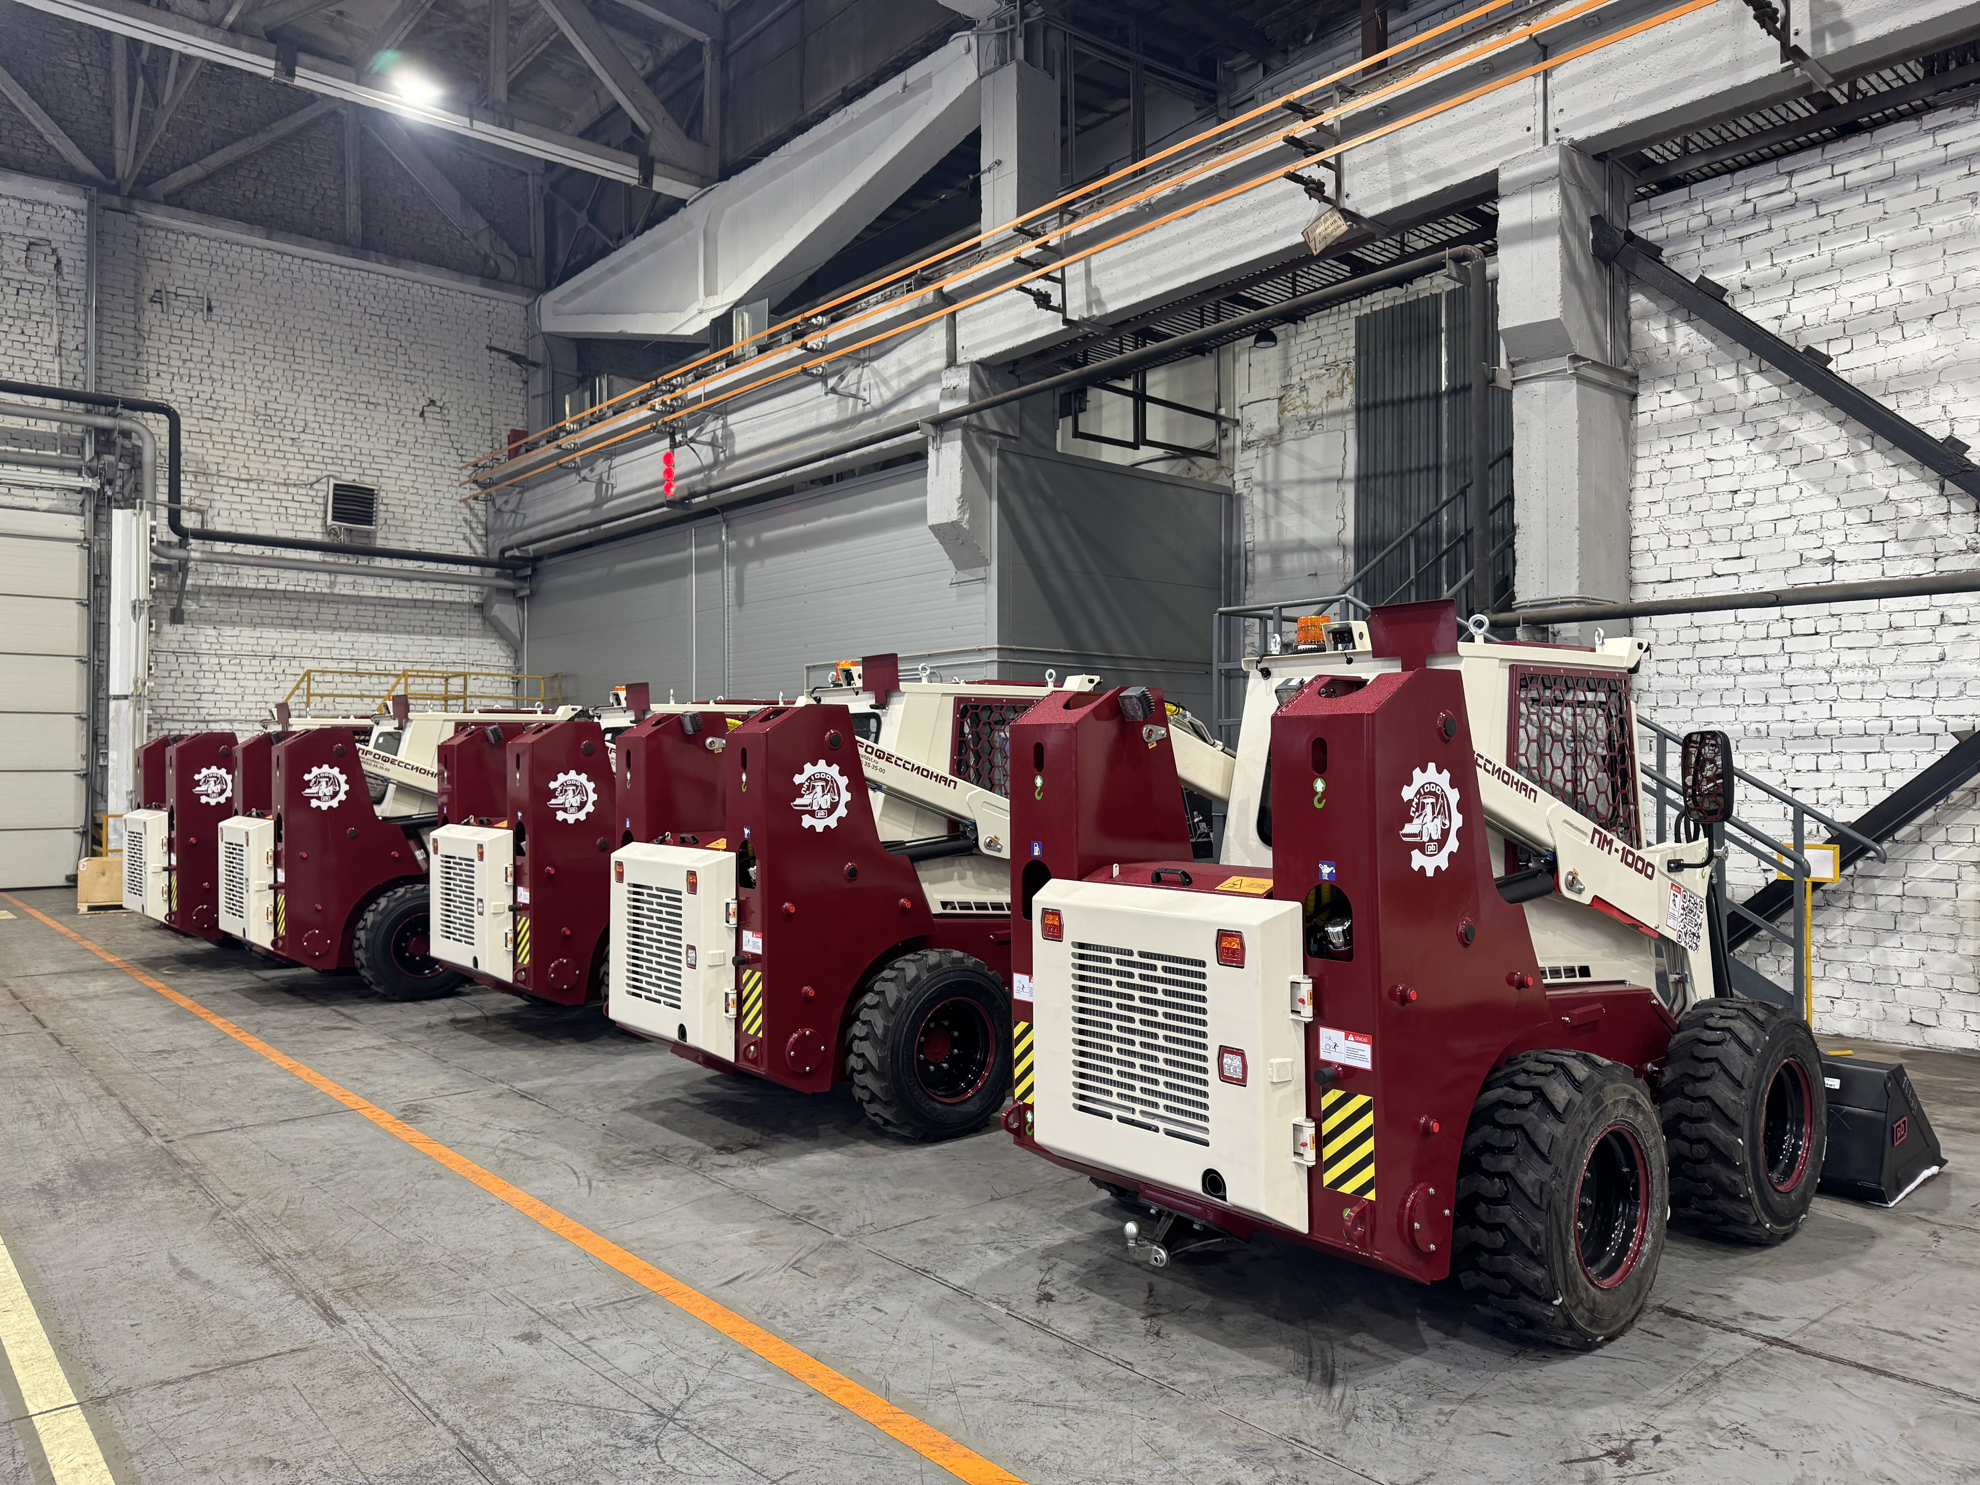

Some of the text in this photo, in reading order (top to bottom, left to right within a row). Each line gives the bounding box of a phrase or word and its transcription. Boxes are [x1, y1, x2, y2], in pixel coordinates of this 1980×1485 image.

[864, 761, 886, 774] 35-35-00
[1474, 751, 1539, 804] ССИОНАЛ
[1410, 783, 1441, 817] ПМ-1000
[1590, 826, 1656, 881] ПМ-1000
